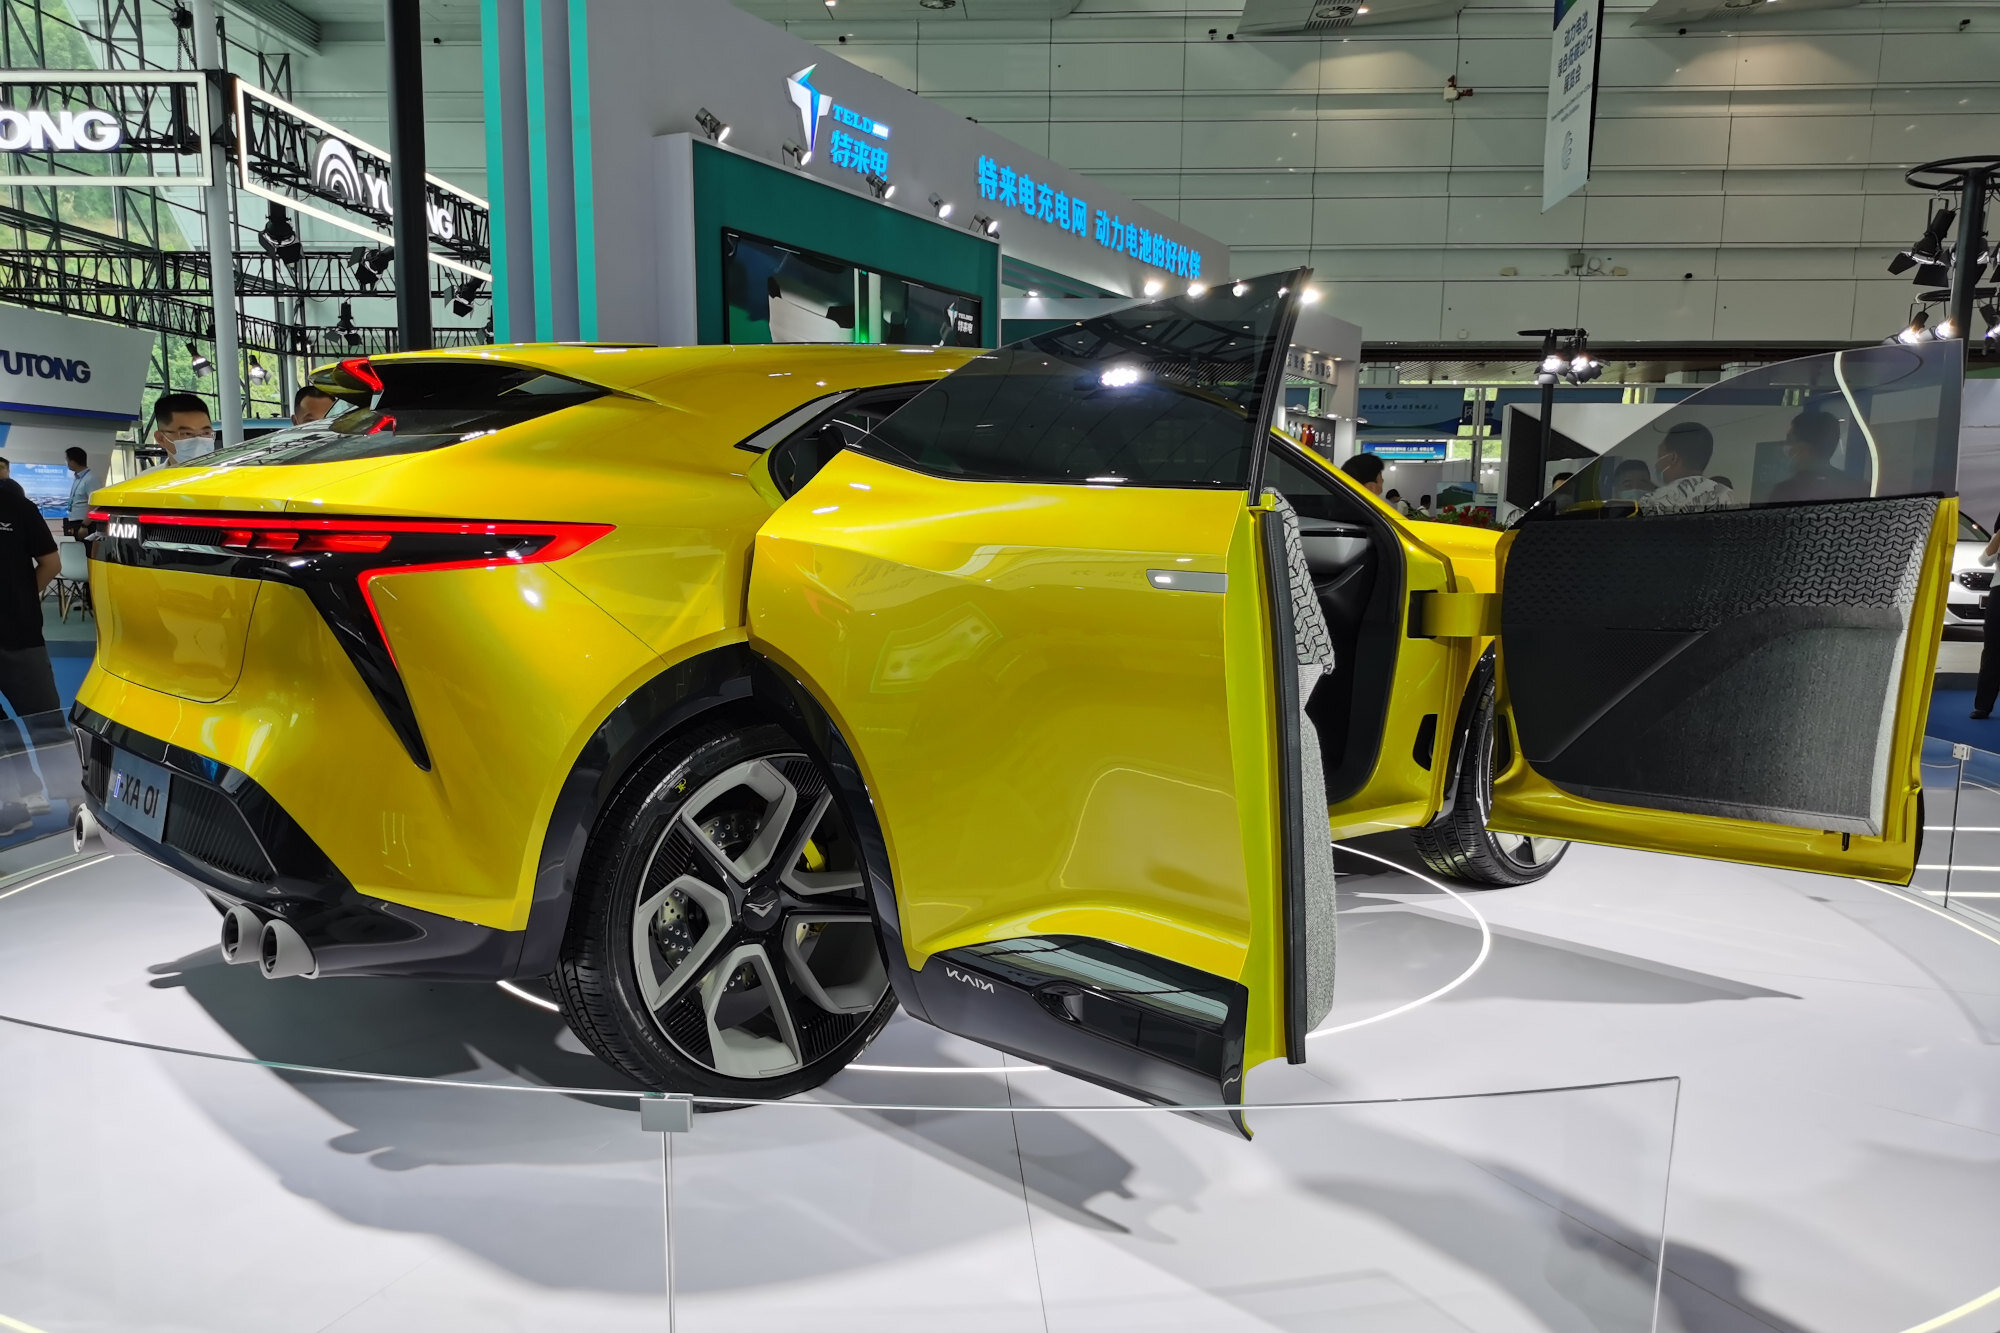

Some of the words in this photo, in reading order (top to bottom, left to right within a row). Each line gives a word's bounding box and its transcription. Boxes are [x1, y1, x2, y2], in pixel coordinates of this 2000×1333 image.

[1564, 10, 1588, 48] 动力电池
[832, 104, 874, 134] TELD
[830, 130, 889, 182] 特来电
[977, 154, 1087, 238] 特来电充电网
[1094, 208, 1202, 280] 动力电池的好伙伴
